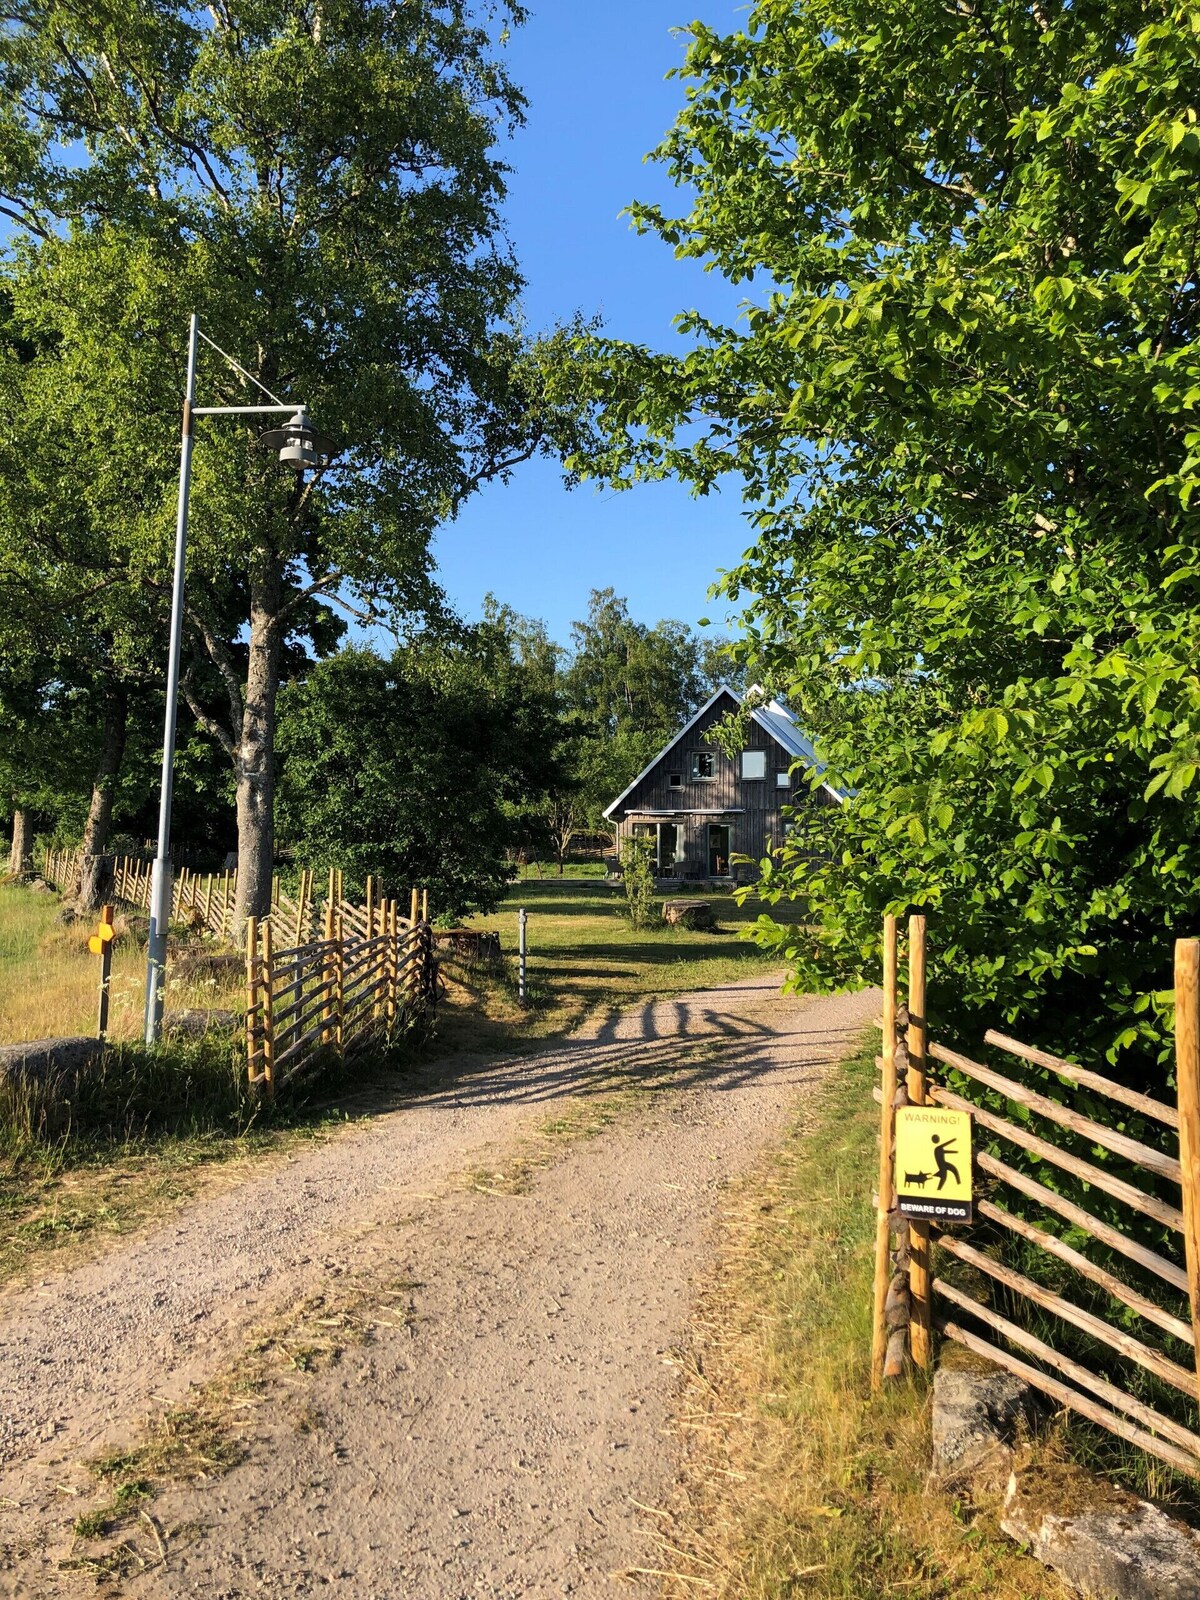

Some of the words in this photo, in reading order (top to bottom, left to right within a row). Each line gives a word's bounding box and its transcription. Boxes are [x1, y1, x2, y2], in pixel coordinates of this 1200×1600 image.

[904, 1112, 961, 1125] WARNING!
[900, 1203, 935, 1214] BEWARE
[935, 1205, 947, 1215] OF
[947, 1207, 966, 1217] DOG
